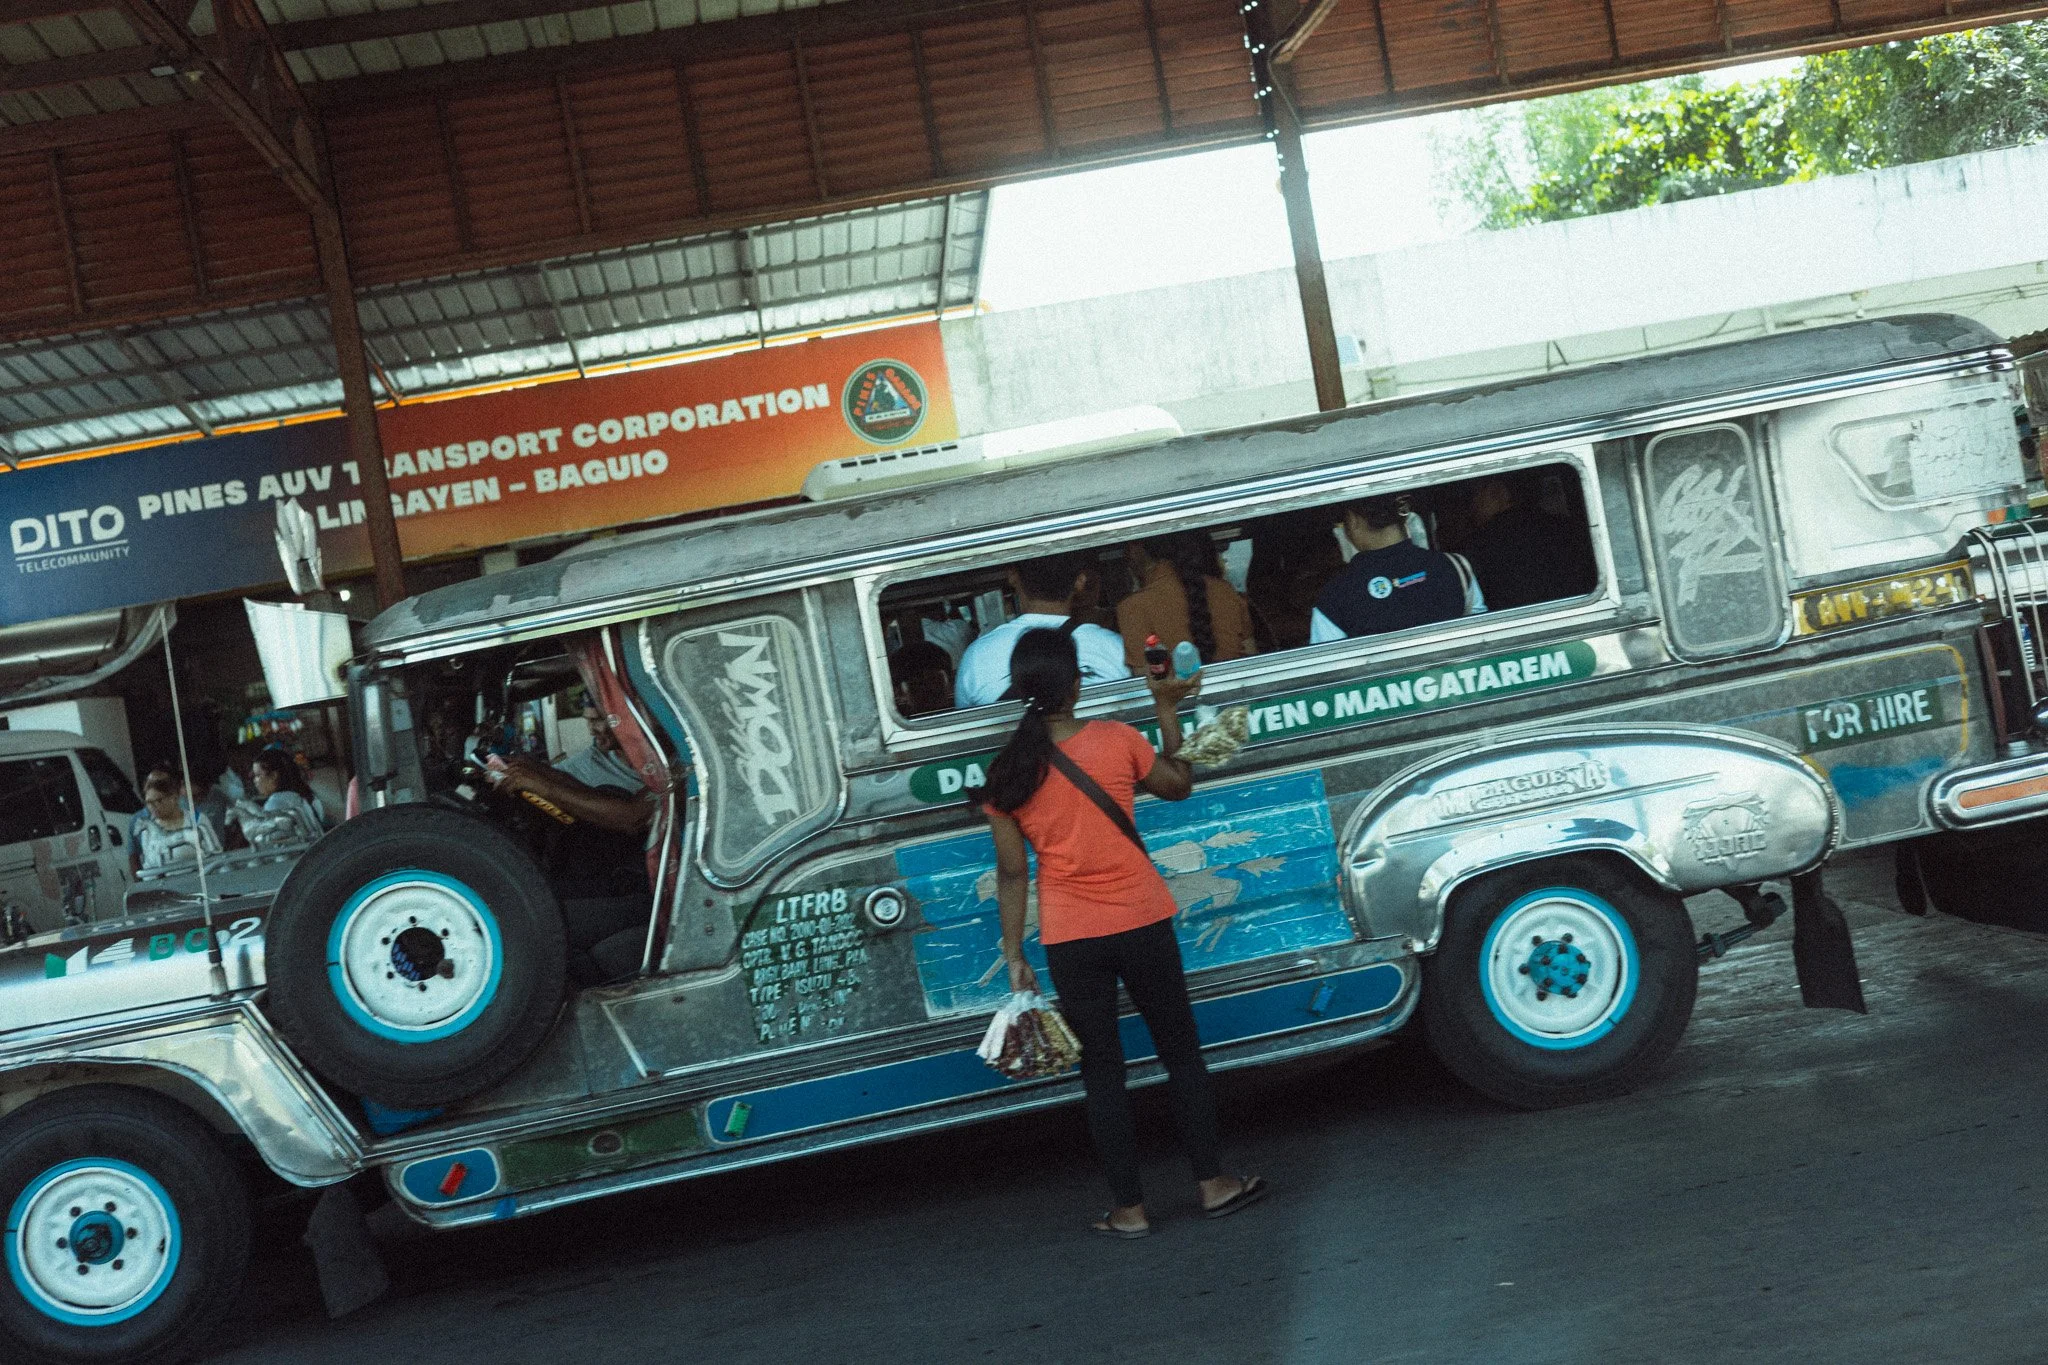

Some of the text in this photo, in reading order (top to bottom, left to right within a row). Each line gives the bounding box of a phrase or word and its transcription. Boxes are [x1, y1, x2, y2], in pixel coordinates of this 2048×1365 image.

[137, 481, 249, 520] PINES
[258, 465, 332, 501] AUV
[572, 383, 830, 448] CORPORATION
[534, 449, 669, 494] BAGUIO
[10, 504, 126, 555] DITO
[17, 546, 130, 574] TELECOMMUNITY
[1334, 650, 1572, 719] MANGATAREM
[1868, 689, 1933, 731] HIRE
[775, 887, 848, 924] LTFRB
